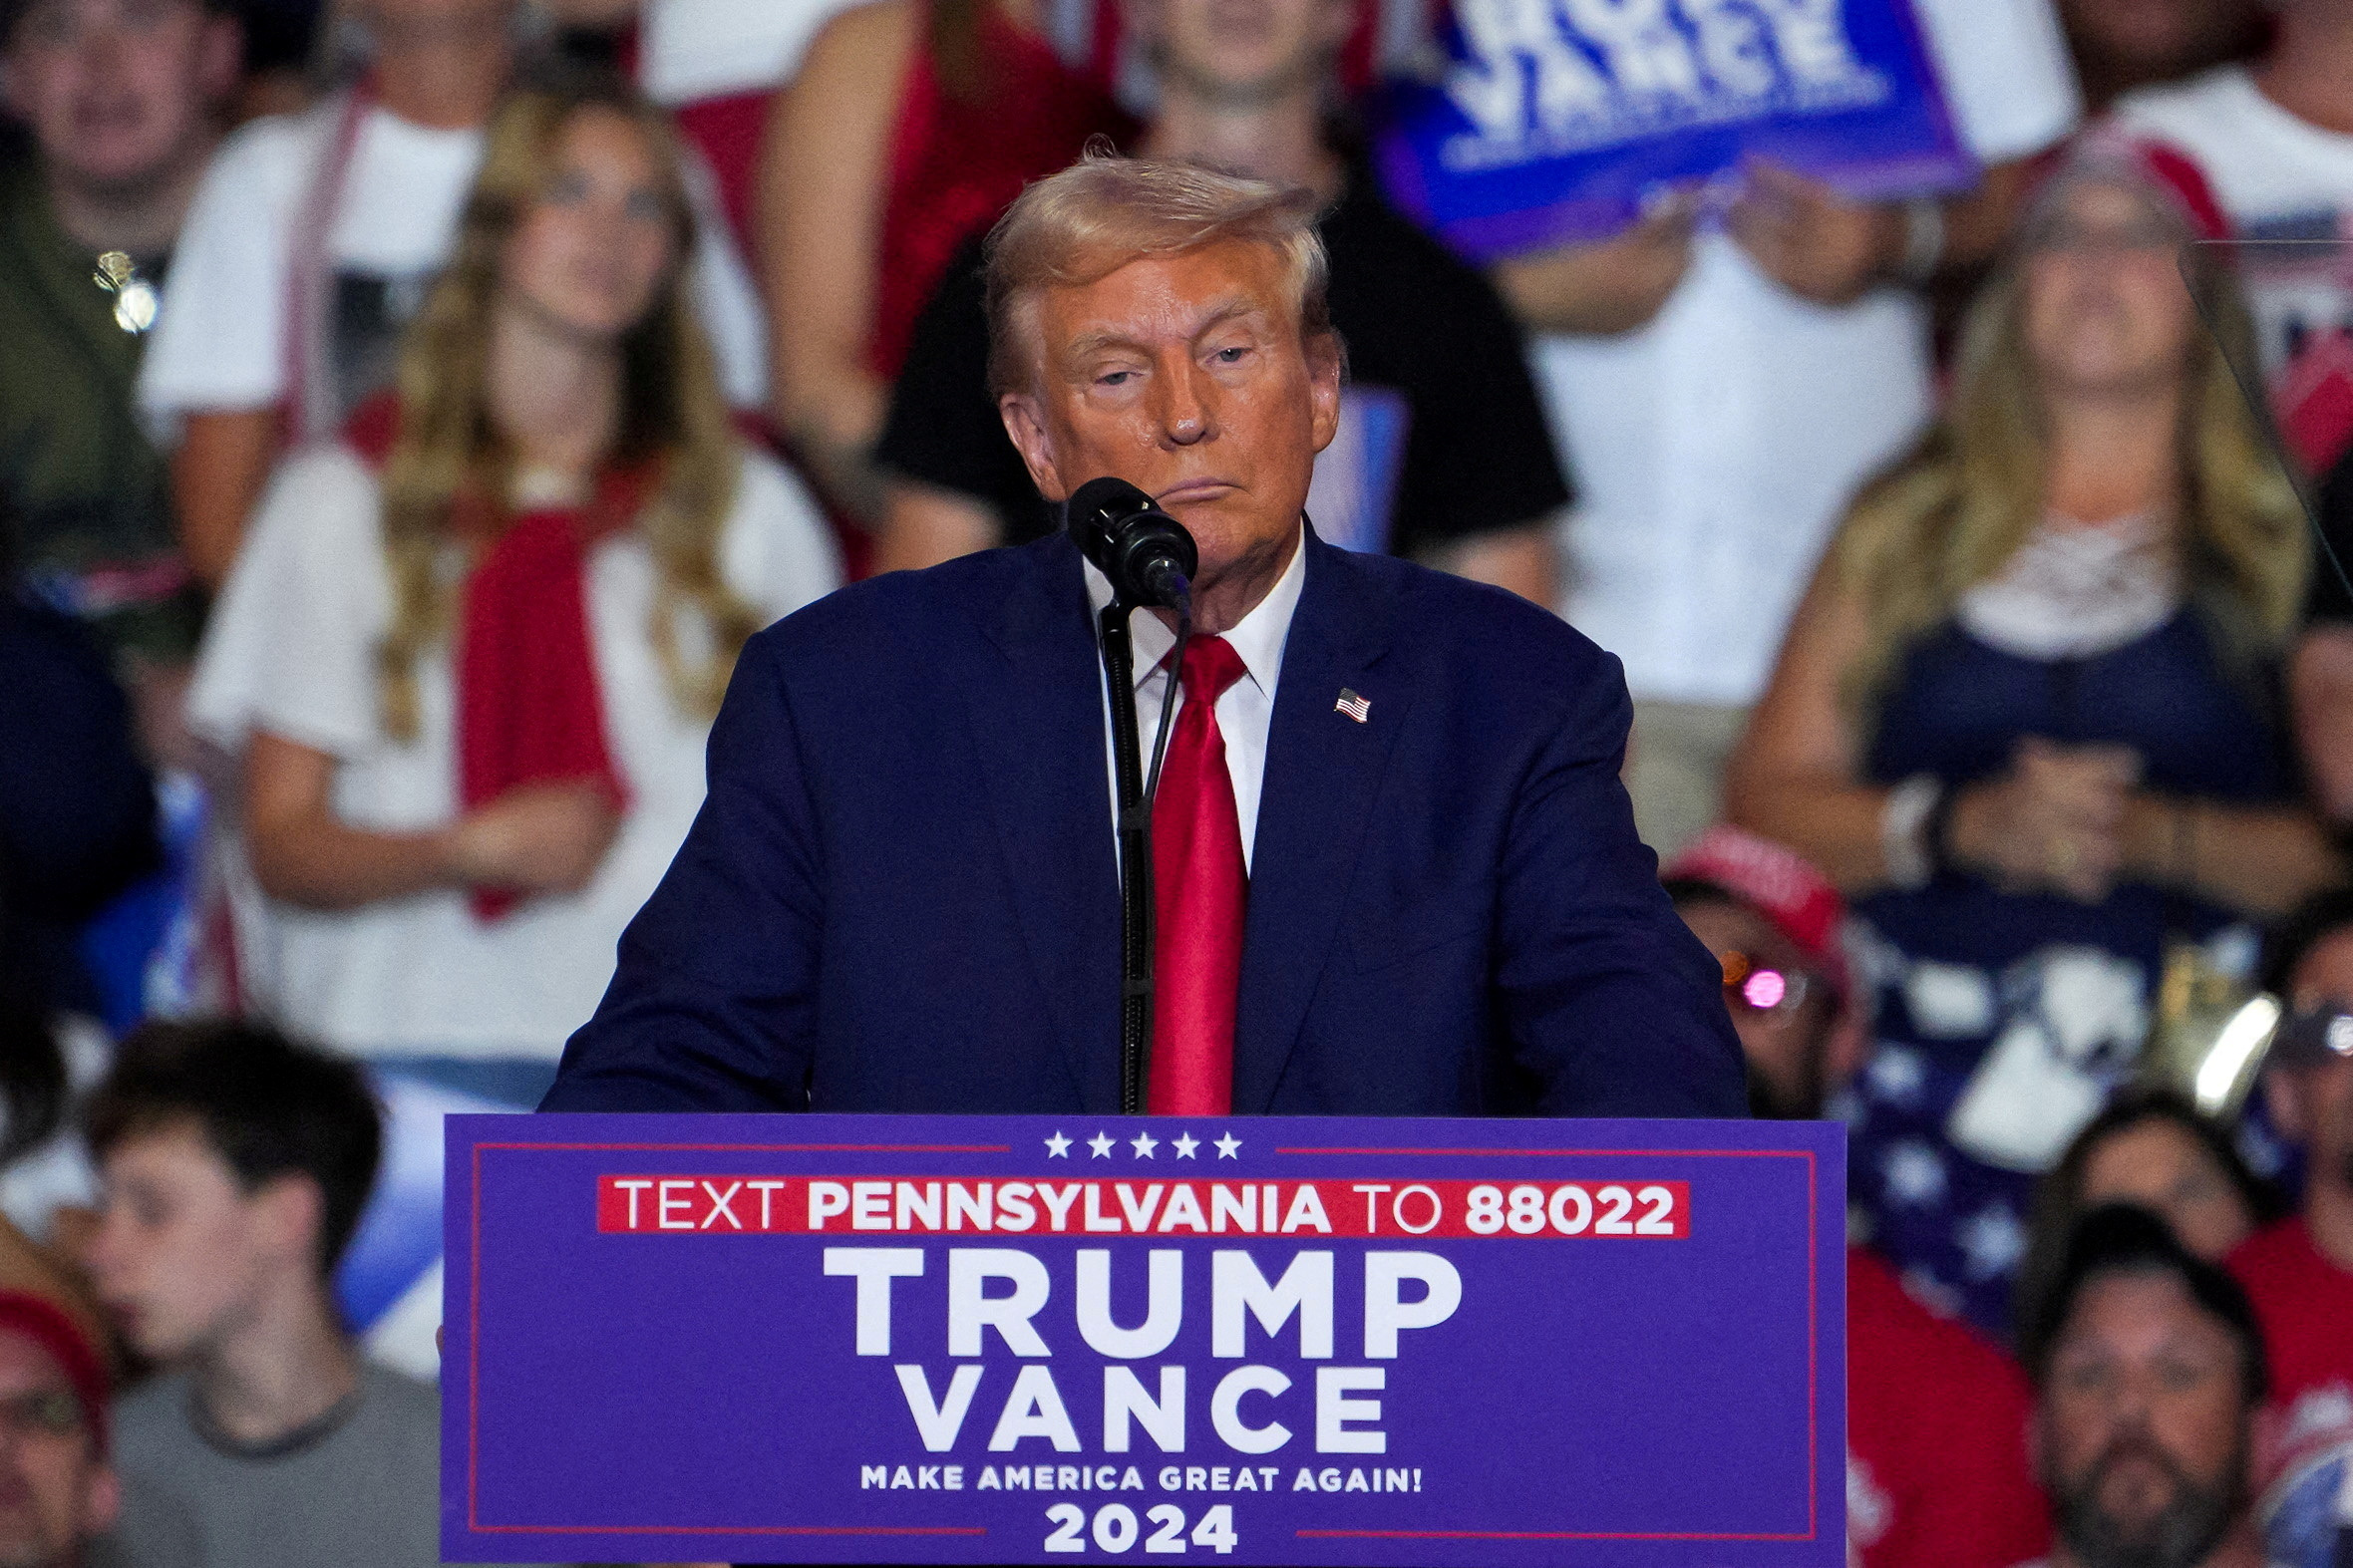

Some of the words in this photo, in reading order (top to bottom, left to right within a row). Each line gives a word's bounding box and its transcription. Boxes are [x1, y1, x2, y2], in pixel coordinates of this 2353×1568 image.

[614, 1180, 785, 1229] TEXT
[808, 1181, 1333, 1233] PENNSYLVANIA
[1352, 1184, 1442, 1234] TO
[1465, 1184, 1674, 1235] 88022
[823, 1247, 1463, 1360] TRUMP
[893, 1364, 1387, 1454] VANCE
[860, 1465, 964, 1490] MAKE
[977, 1466, 1145, 1492] AMERICA
[1159, 1467, 1279, 1492] GREAT
[1292, 1467, 1423, 1493] AGAIN!
[1043, 1502, 1238, 1554] 2024
